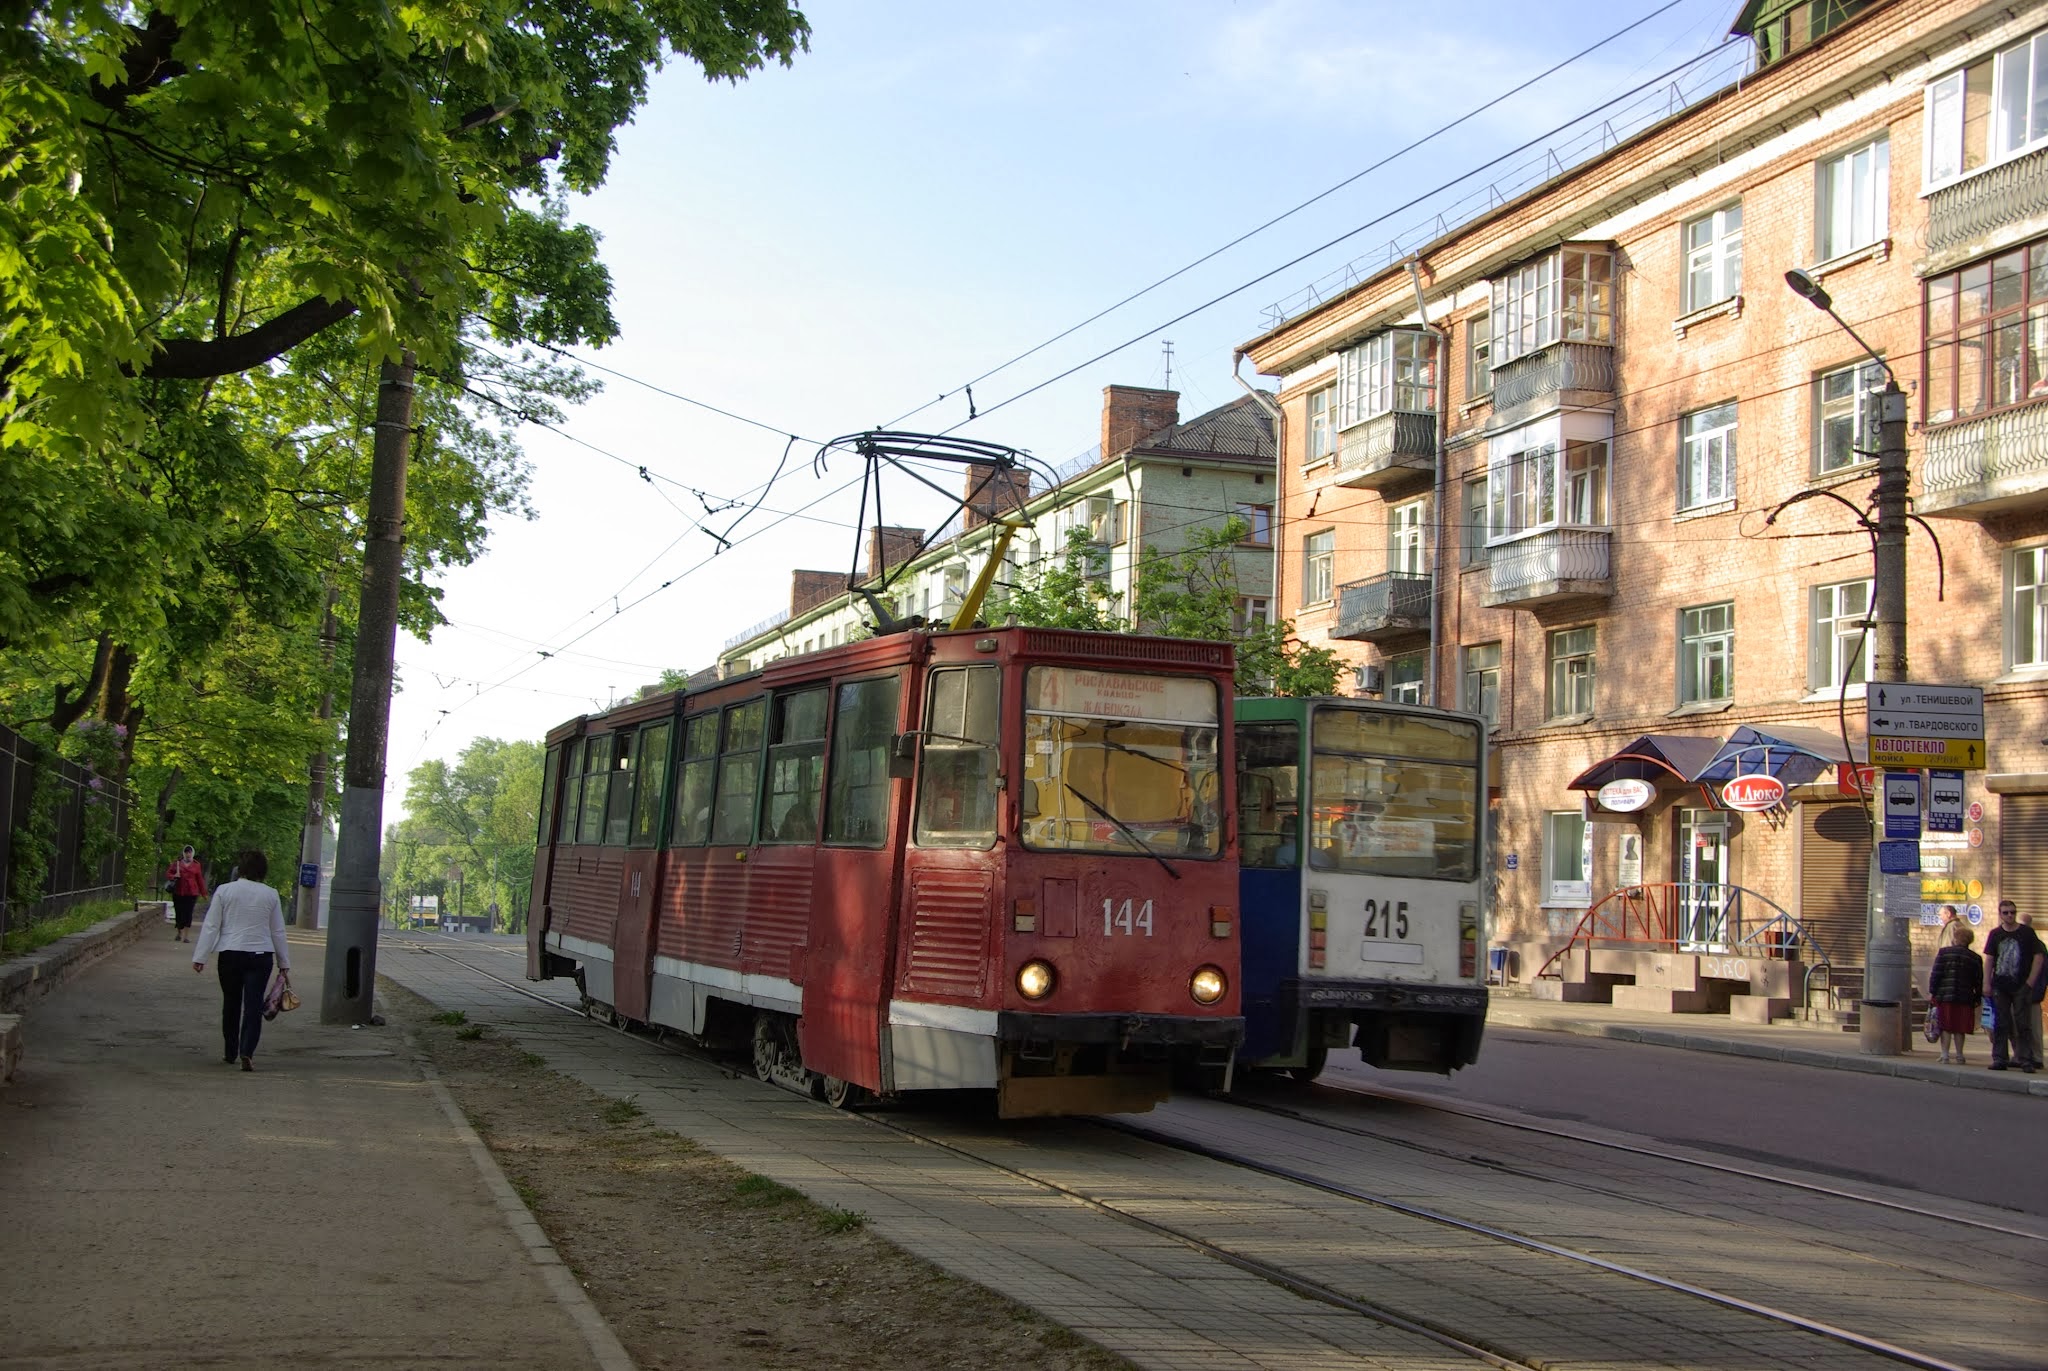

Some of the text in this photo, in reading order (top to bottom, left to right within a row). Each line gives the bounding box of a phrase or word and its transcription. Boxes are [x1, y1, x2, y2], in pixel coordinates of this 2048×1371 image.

[1042, 670, 1060, 706] 4
[1874, 738, 1945, 754] АВТОСТЕКЛО
[1874, 753, 1904, 763] МОЙКА
[1102, 898, 1154, 937] 144
[1364, 899, 1409, 939] 215
